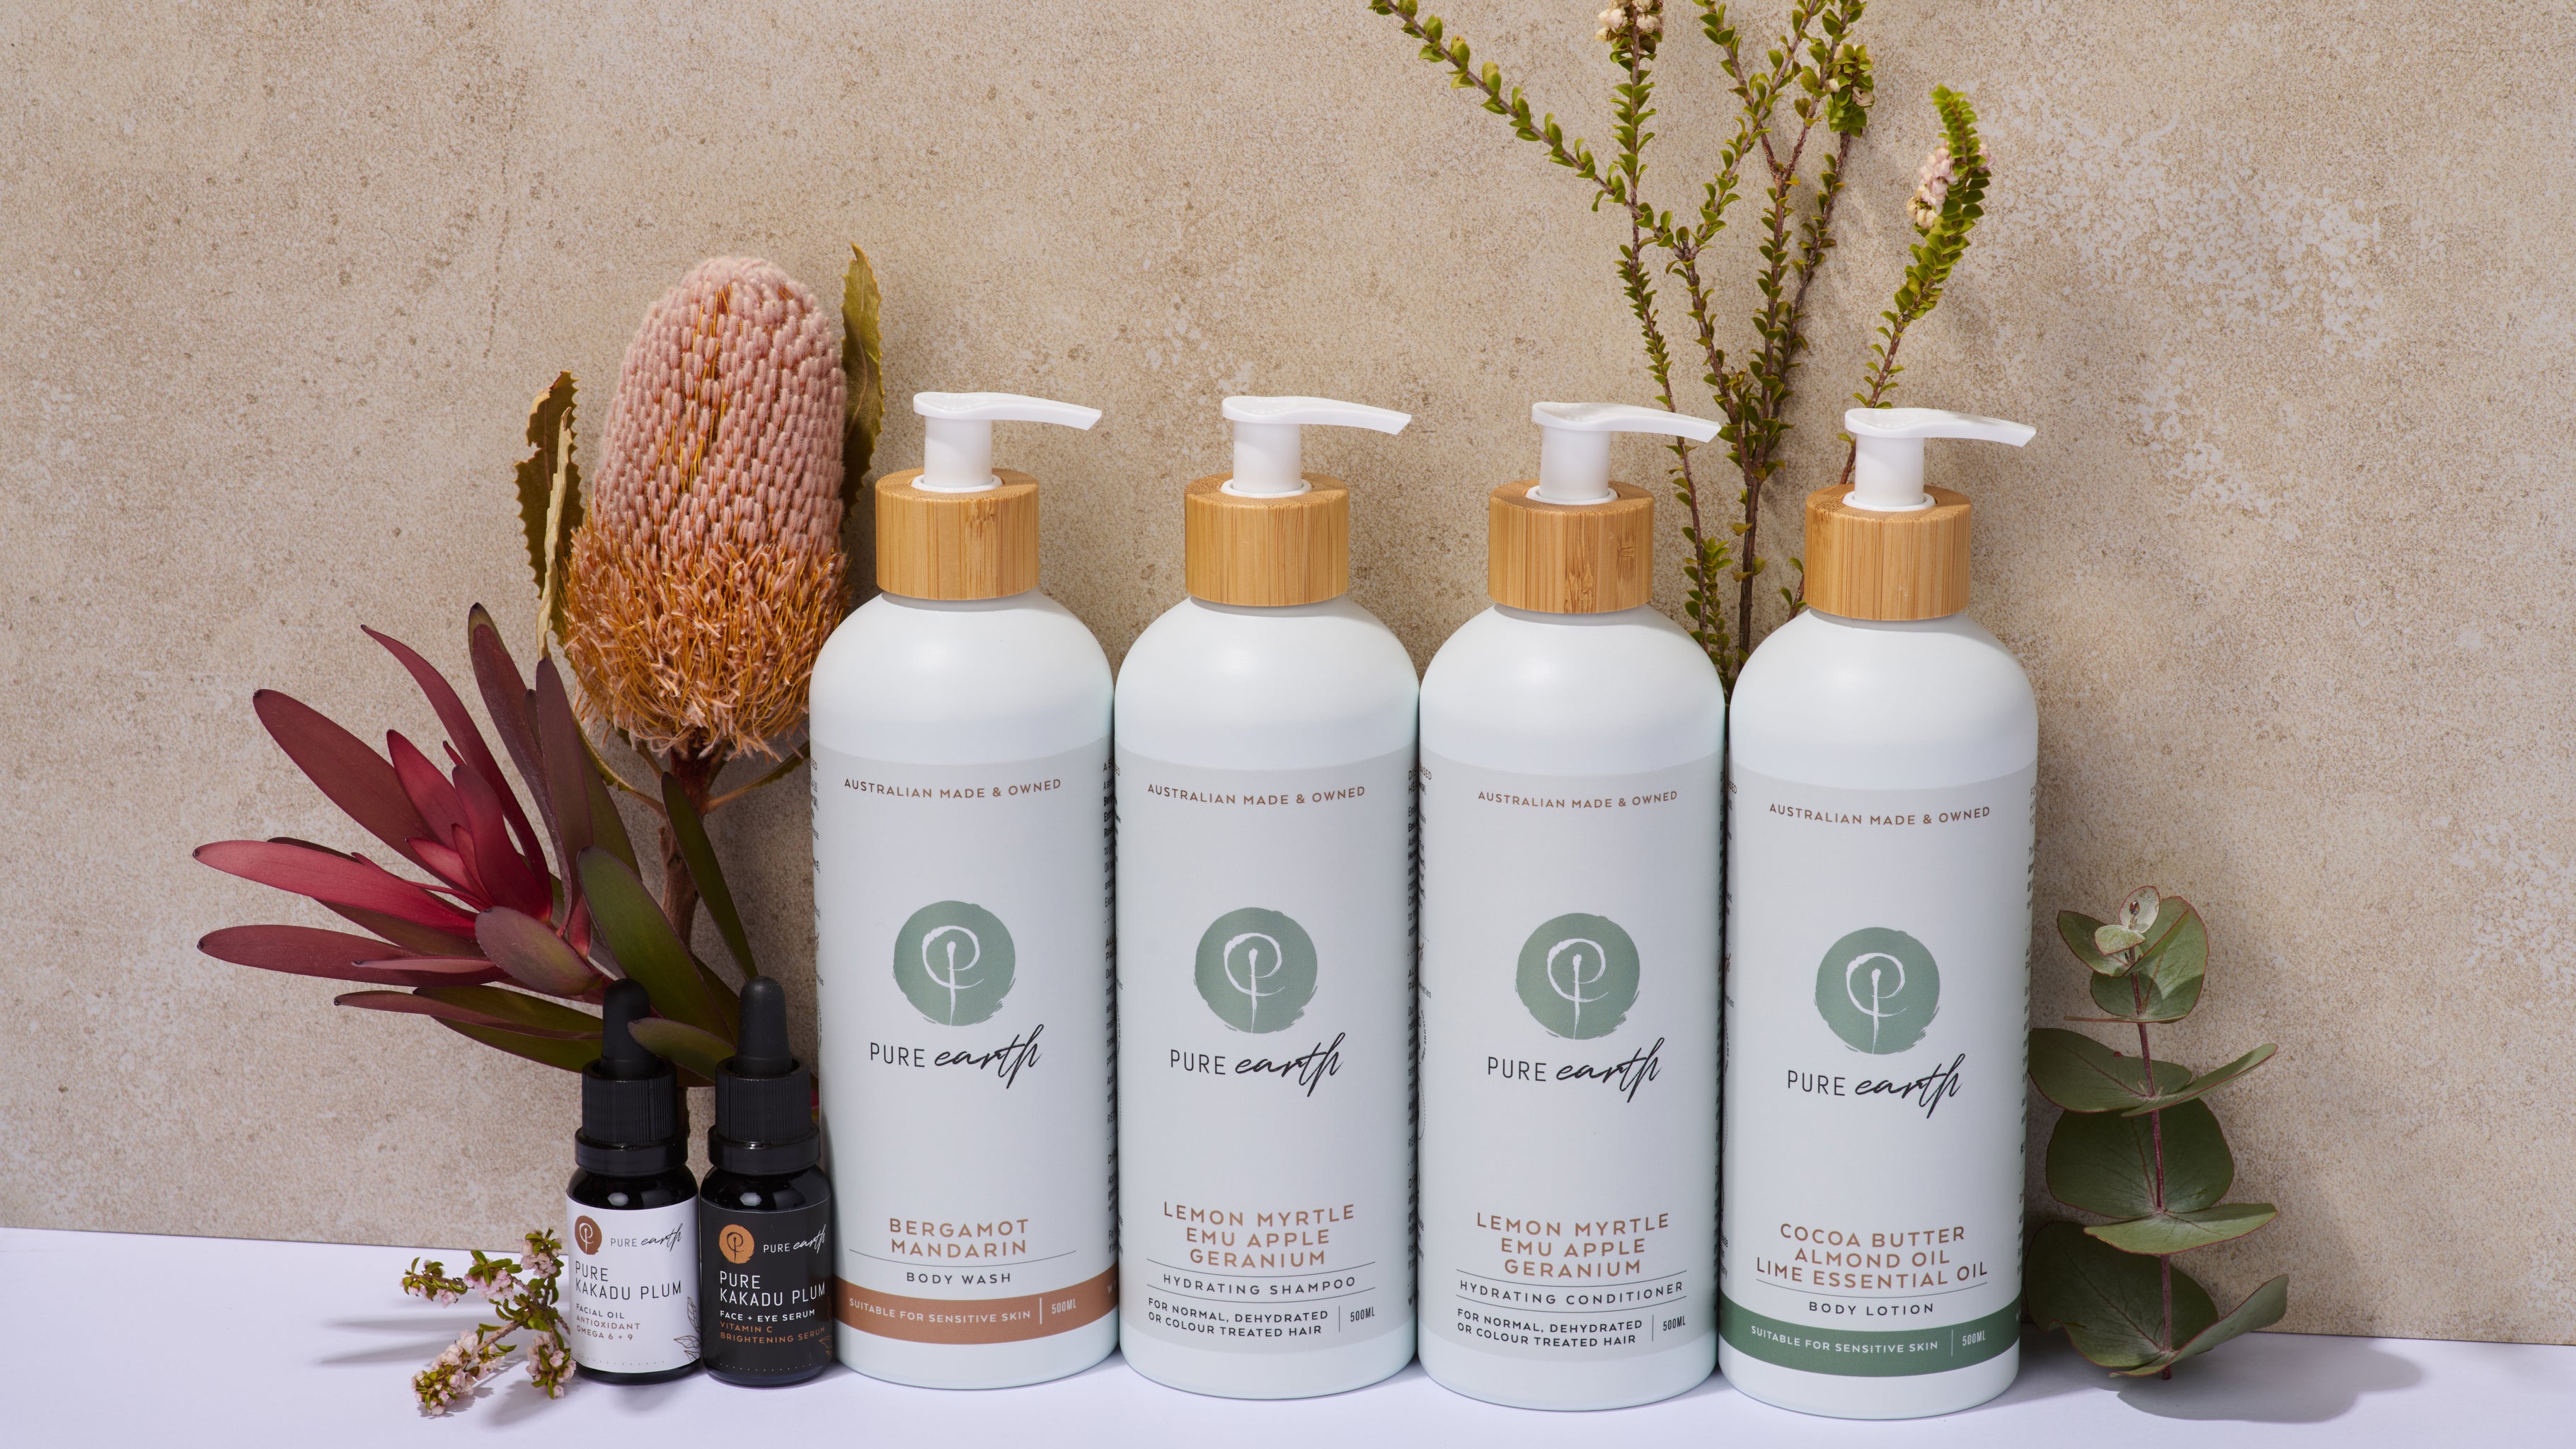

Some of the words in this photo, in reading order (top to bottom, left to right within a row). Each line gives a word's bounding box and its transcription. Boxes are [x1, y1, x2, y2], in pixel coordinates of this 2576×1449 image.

[844, 778, 931, 797] AUSTRALIAN
[941, 788, 984, 798] MADE
[992, 787, 1001, 797] &
[1008, 779, 1060, 795] OWNED
[1148, 784, 1235, 804] AUSTRALIAN
[1244, 795, 1288, 804] MADE
[1296, 794, 1305, 804] &
[1312, 787, 1364, 802] OWNED
[1478, 791, 1565, 808] AUSTRALIAN
[1572, 799, 1611, 808] MADE
[1618, 798, 1626, 807] &
[1633, 791, 1677, 805] OWNED
[1769, 804, 1861, 824] AUSTRALIAN
[1870, 815, 1915, 825] MADE
[1923, 814, 1931, 824] &
[1939, 807, 1989, 823] OWNED
[870, 1042, 925, 1067] PURE
[934, 1024, 1044, 1089] earth
[1171, 1049, 1225, 1075] PURE
[1235, 1032, 1345, 1097] earth
[1488, 1056, 1546, 1081] PURE
[1556, 1037, 1664, 1103] earth
[1788, 1070, 1845, 1096] PURE
[1855, 1053, 1965, 1119] earth
[1164, 1201, 1243, 1226] LEMON
[1258, 1204, 1353, 1227] MYRTLE
[1478, 1212, 1560, 1236] LEMON
[1575, 1213, 1668, 1236] MYRTLE
[611, 1238, 637, 1247] PURE
[641, 1223, 683, 1252] earth
[890, 1218, 1028, 1237] BERGAMOT
[1187, 1227, 1234, 1246] EMU
[1247, 1229, 1328, 1247] APPLE
[1781, 1223, 1861, 1247] COCOA
[1873, 1226, 1964, 1247] BUTTER
[764, 1243, 790, 1252] PURE
[793, 1224, 826, 1254] earth
[892, 1239, 1025, 1258] MANDARIN
[1502, 1237, 1551, 1257] EMU
[1564, 1238, 1645, 1257] APPLE
[1190, 1249, 1324, 1268] GERANIUM
[1795, 1247, 1899, 1268] ALMOND
[1912, 1250, 1950, 1266] OIL
[575, 1261, 609, 1282] PURE
[907, 1272, 953, 1284] BODY
[962, 1274, 1010, 1284] WASH
[1505, 1259, 1640, 1278] GERANIUM
[1757, 1257, 1802, 1282] LIME
[1814, 1270, 1948, 1288] ESSENTIAL
[1957, 1262, 1987, 1281] OIL
[576, 1278, 630, 1300] KAKADU
[641, 1281, 681, 1299] PLUM
[720, 1271, 760, 1288] PURE
[1163, 1274, 1260, 1295] HYDRATING
[1270, 1277, 1355, 1295] SHAMPOO
[720, 1288, 782, 1306] KAKADU
[793, 1282, 824, 1304] PLUM
[1460, 1280, 1556, 1305] HYDRATING
[1566, 1281, 1683, 1305] CONDITIONER
[576, 1303, 603, 1318] FACIAL
[720, 1310, 743, 1320] FACE
[783, 1309, 815, 1321] SERUM
[850, 1298, 895, 1317] SUITABLE
[900, 1311, 924, 1321] FOR
[929, 1314, 996, 1323] SENSITIVE
[1002, 1310, 1030, 1321] SKIN
[1052, 1298, 1076, 1314] 500ML
[1149, 1298, 1167, 1311] FOR
[1173, 1305, 1229, 1322] NORMAL,
[1235, 1311, 1328, 1322] DEHYDRATED
[1350, 1307, 1375, 1322] 500ML
[1810, 1302, 1856, 1315] BODY
[1867, 1303, 1933, 1315] LOTION
[576, 1315, 640, 1330] ANTIOXIDANT
[720, 1322, 761, 1332] VITAMIN
[1149, 1312, 1161, 1323] OR
[1166, 1317, 1214, 1334] COLOUR
[1220, 1327, 1282, 1337] TREATED
[1289, 1326, 1321, 1336] HAIR
[1458, 1308, 1478, 1322] FOR
[1485, 1316, 1543, 1332] NORMAL,
[1551, 1320, 1642, 1333] DEHYDRATED
[1663, 1316, 1686, 1331] 500ML
[577, 1325, 604, 1339] OMEGA
[720, 1332, 793, 1344] BRIGHTENING
[798, 1327, 825, 1341] SERUM
[1458, 1322, 1471, 1334] OR
[1477, 1328, 1528, 1344] COLOUR
[1534, 1337, 1597, 1346] TREATED
[1604, 1335, 1635, 1346] HAIR
[1752, 1326, 1800, 1346] SUITABLE
[1805, 1339, 1829, 1351] FOR
[1835, 1344, 1904, 1353] SENSITIVE
[1909, 1341, 1937, 1351] SKIN
[1962, 1330, 1985, 1346] 500ML
